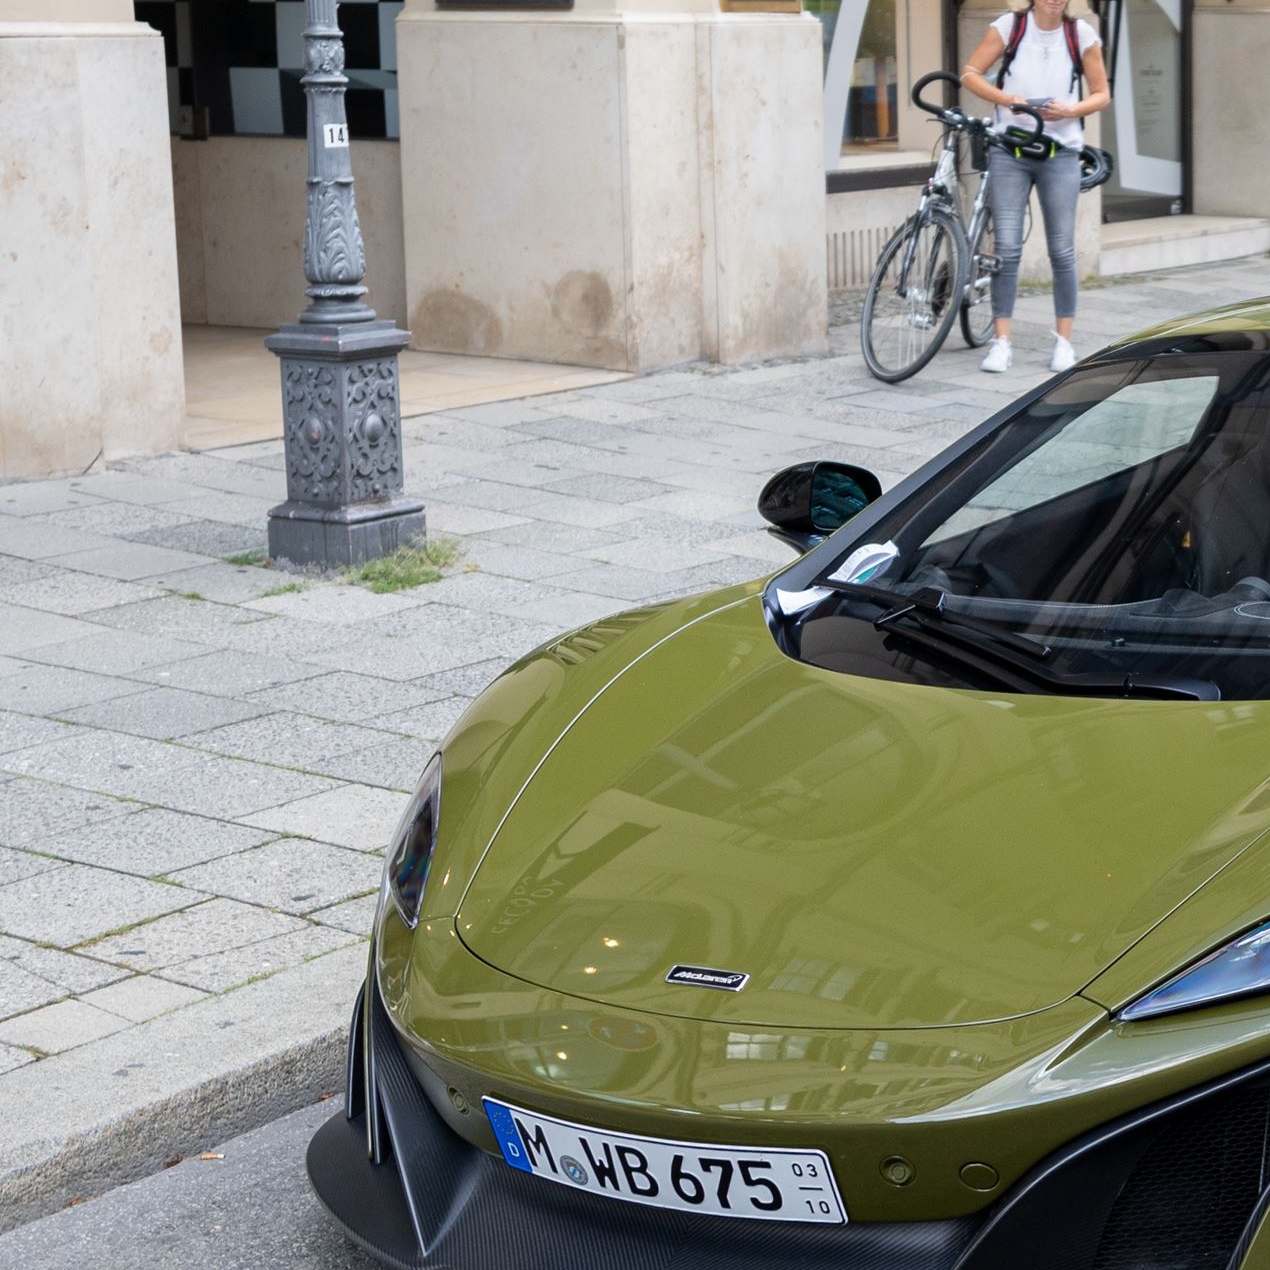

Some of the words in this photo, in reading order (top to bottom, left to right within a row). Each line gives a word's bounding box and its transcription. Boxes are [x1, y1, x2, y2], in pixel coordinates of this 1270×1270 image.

[329, 128, 345, 143] 14
[674, 971, 733, 984] McLaren
[506, 1141, 520, 1158] D
[514, 1116, 558, 1174] M
[578, 1136, 660, 1198] WB
[670, 1153, 784, 1212] 675
[791, 1162, 819, 1178] 03
[805, 1199, 831, 1215] 10
